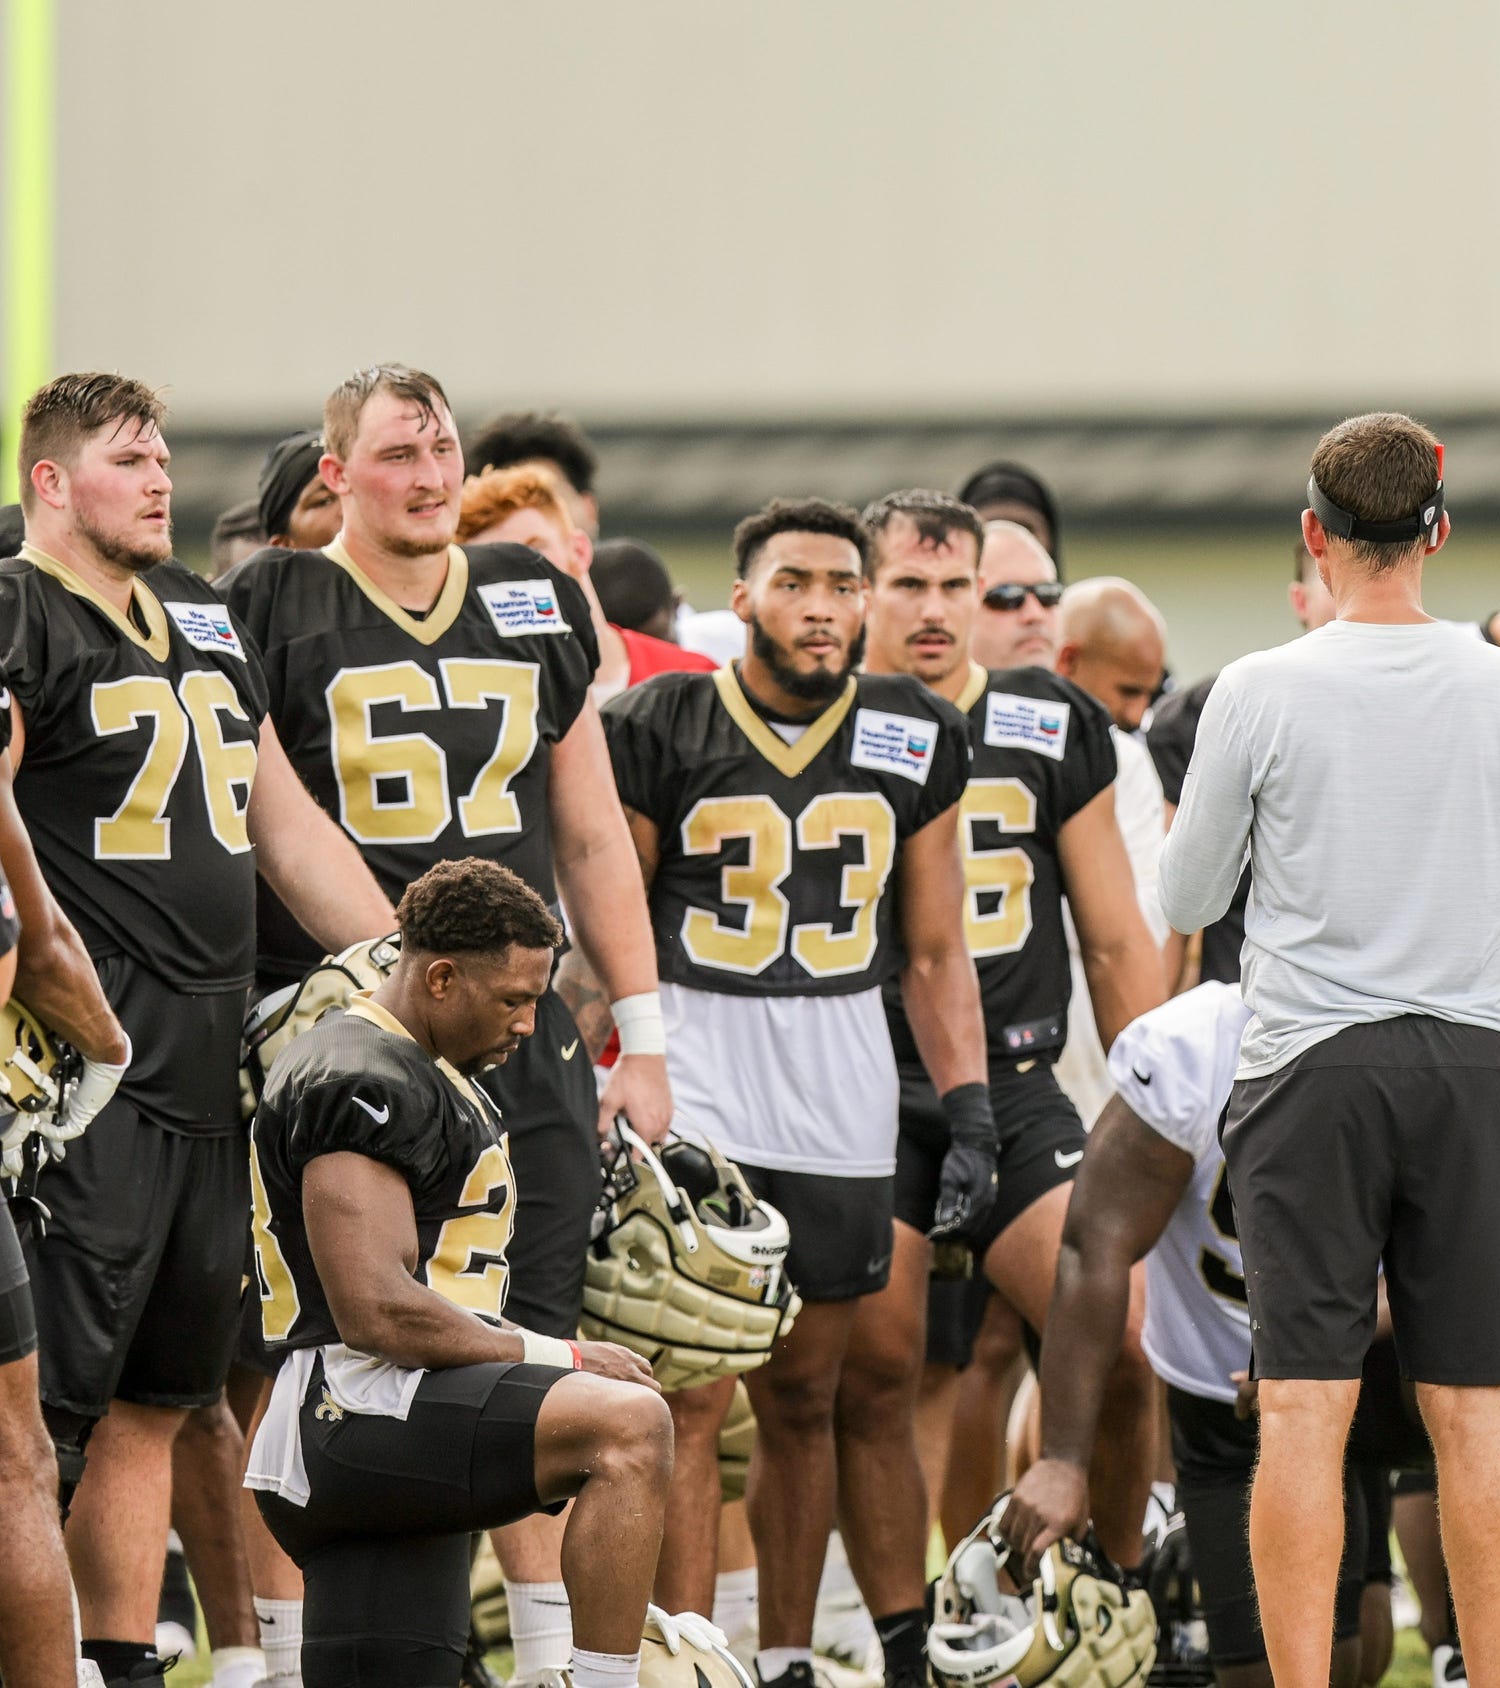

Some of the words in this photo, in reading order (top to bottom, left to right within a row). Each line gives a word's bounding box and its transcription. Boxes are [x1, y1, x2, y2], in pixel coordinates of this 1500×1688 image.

[91, 670, 259, 860] 76
[325, 657, 540, 845] 67
[680, 792, 896, 978] 33
[958, 778, 1037, 958] 6
[426, 1131, 517, 1319] 2
